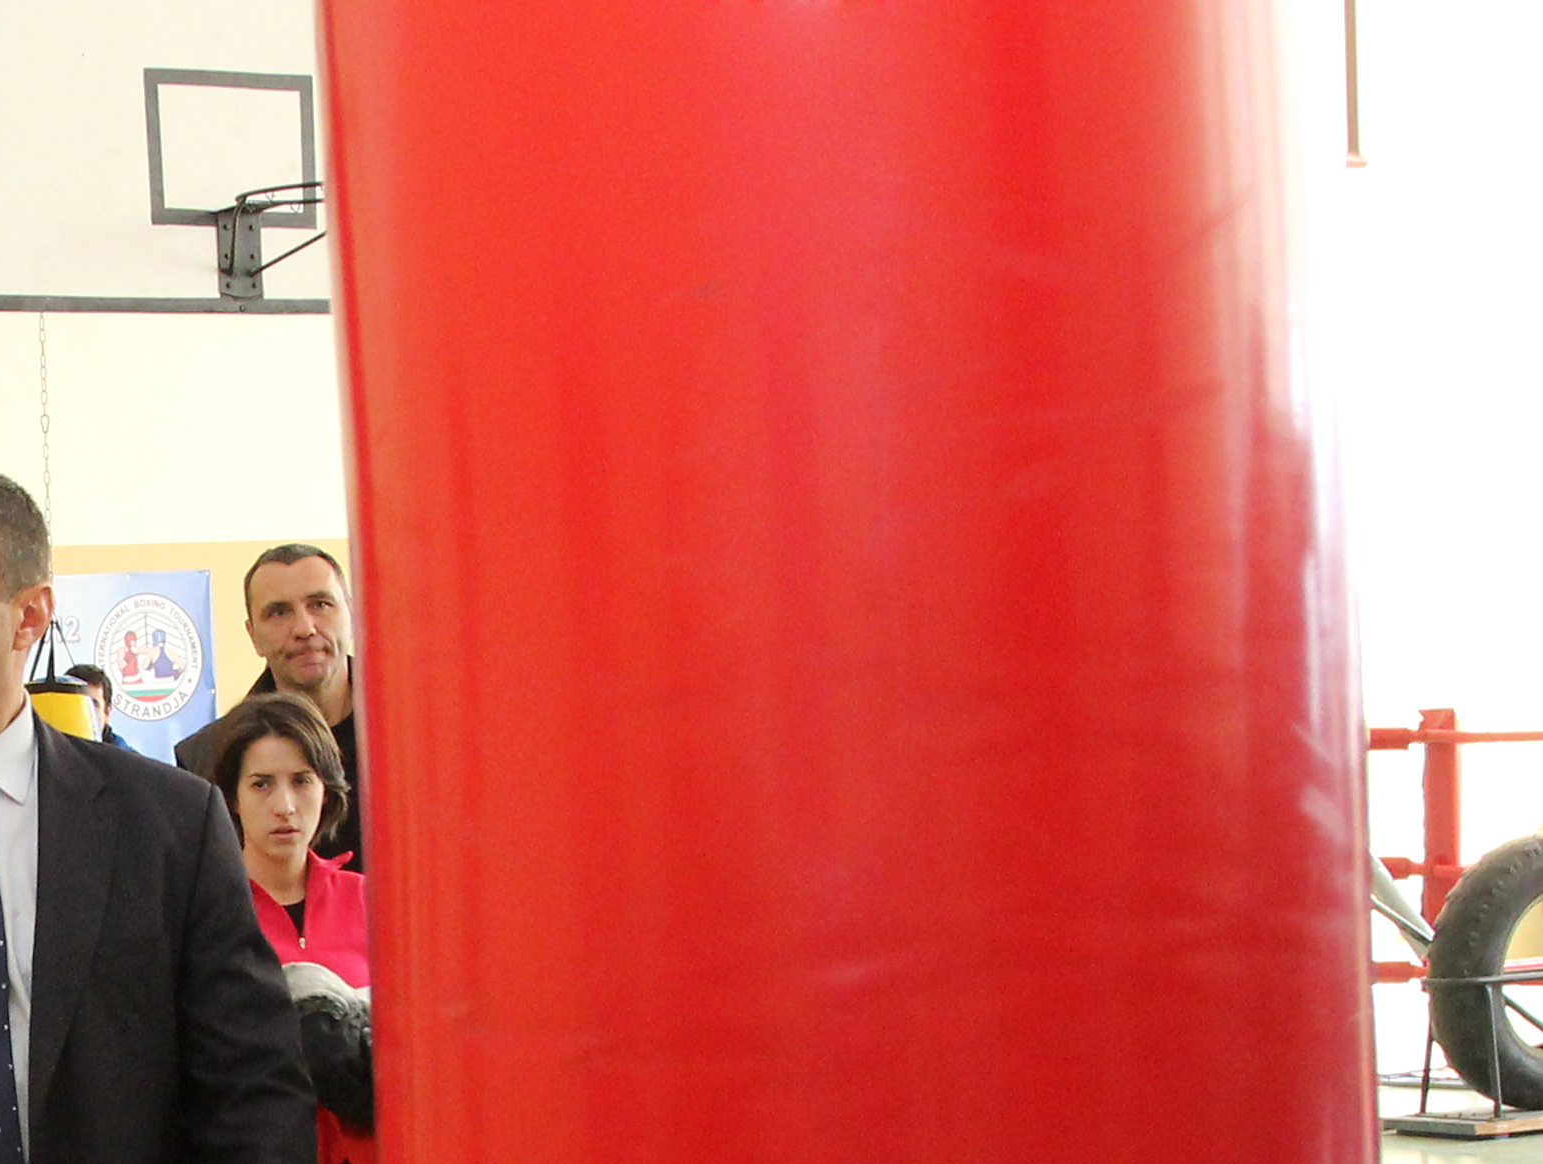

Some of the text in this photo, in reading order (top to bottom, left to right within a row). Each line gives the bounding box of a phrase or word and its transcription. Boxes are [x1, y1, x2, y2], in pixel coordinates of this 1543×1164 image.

[133, 599, 166, 610] BOXING
[169, 607, 198, 671] TOURNAMENT
[113, 691, 188, 718] STRANDJA
